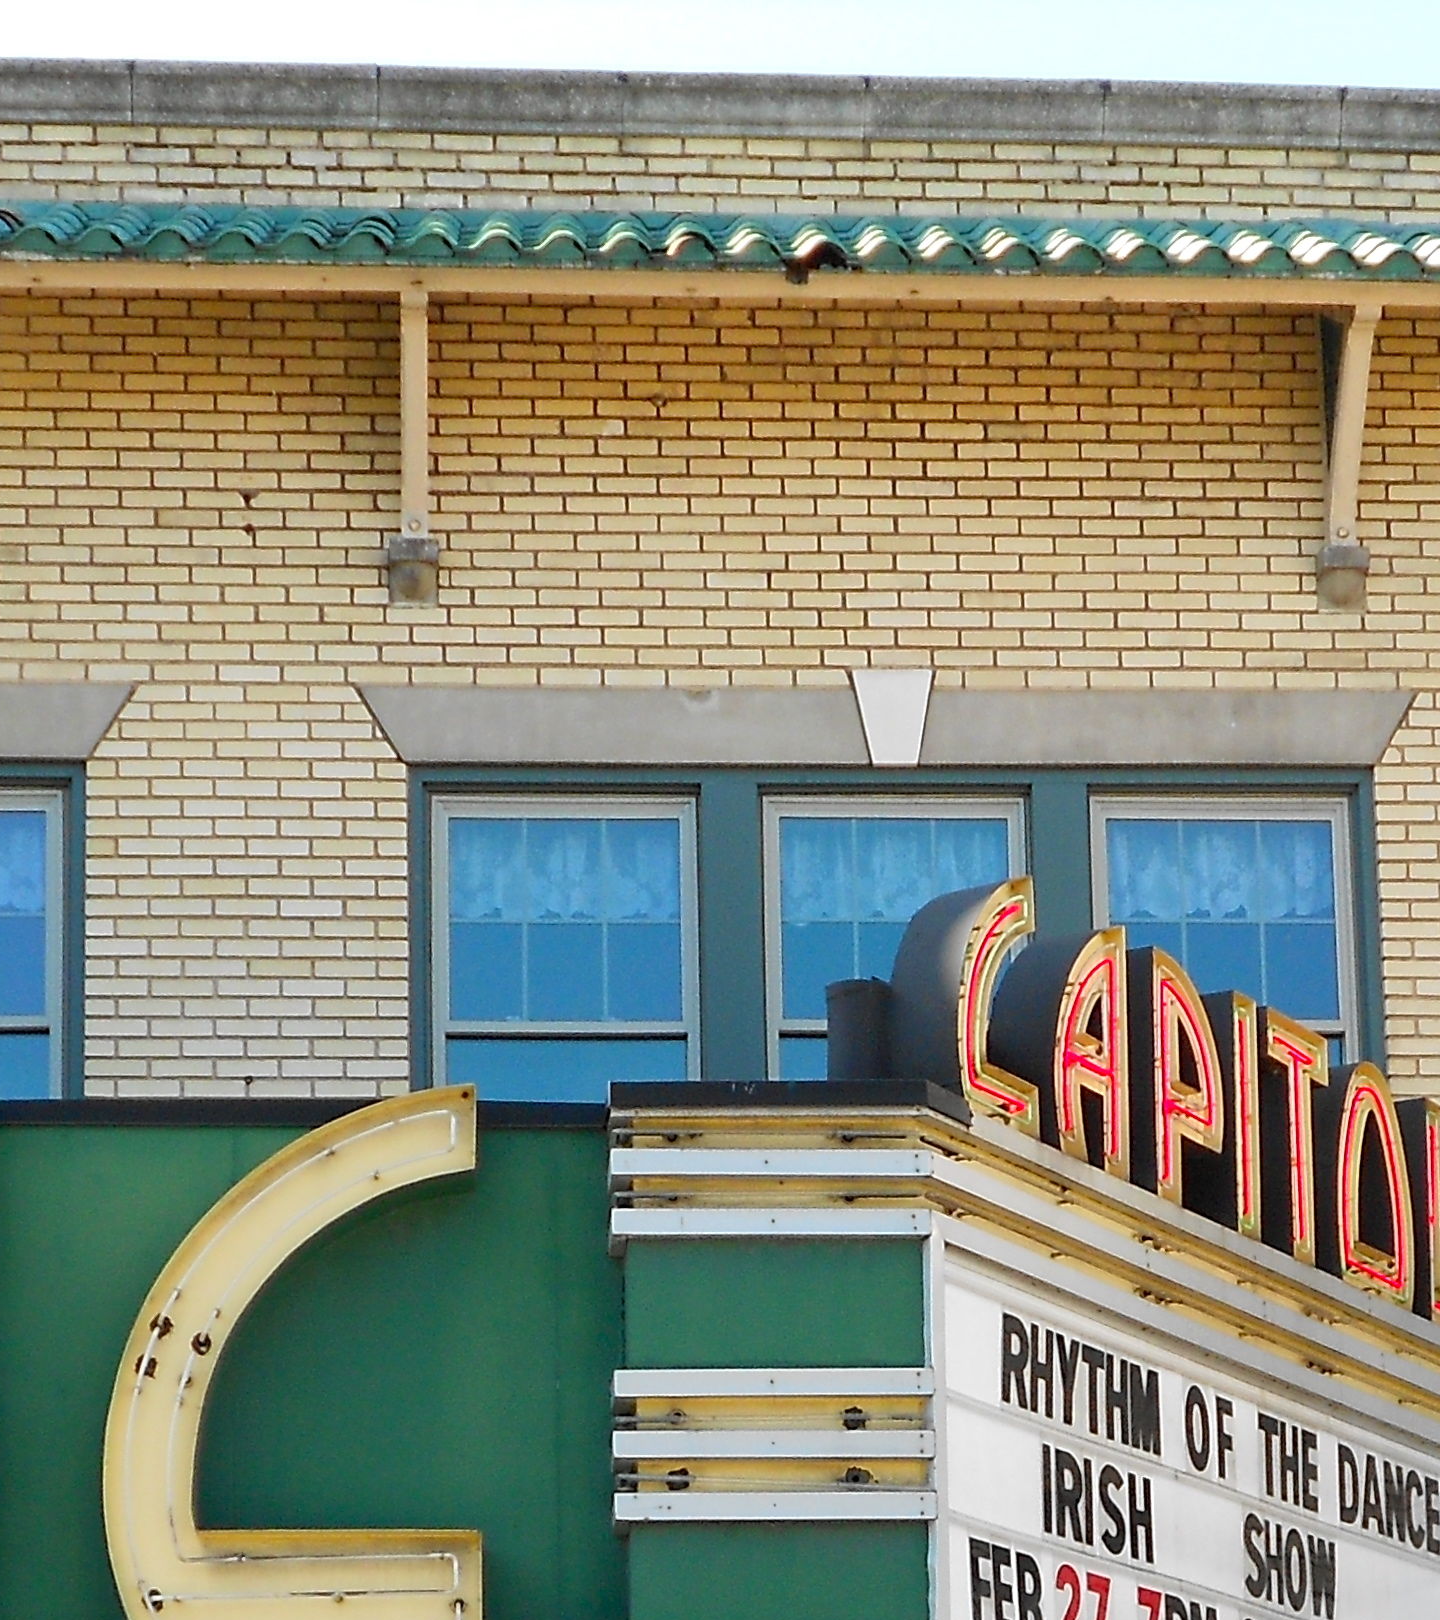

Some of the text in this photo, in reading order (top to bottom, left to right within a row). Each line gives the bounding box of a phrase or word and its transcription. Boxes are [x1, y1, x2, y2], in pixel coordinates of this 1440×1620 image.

[1001, 1312, 1162, 1456] RHYTHM
[1184, 1384, 1234, 1479] OF
[1258, 1412, 1320, 1514] THE
[1040, 1443, 1336, 1620] IRISH SHOW
